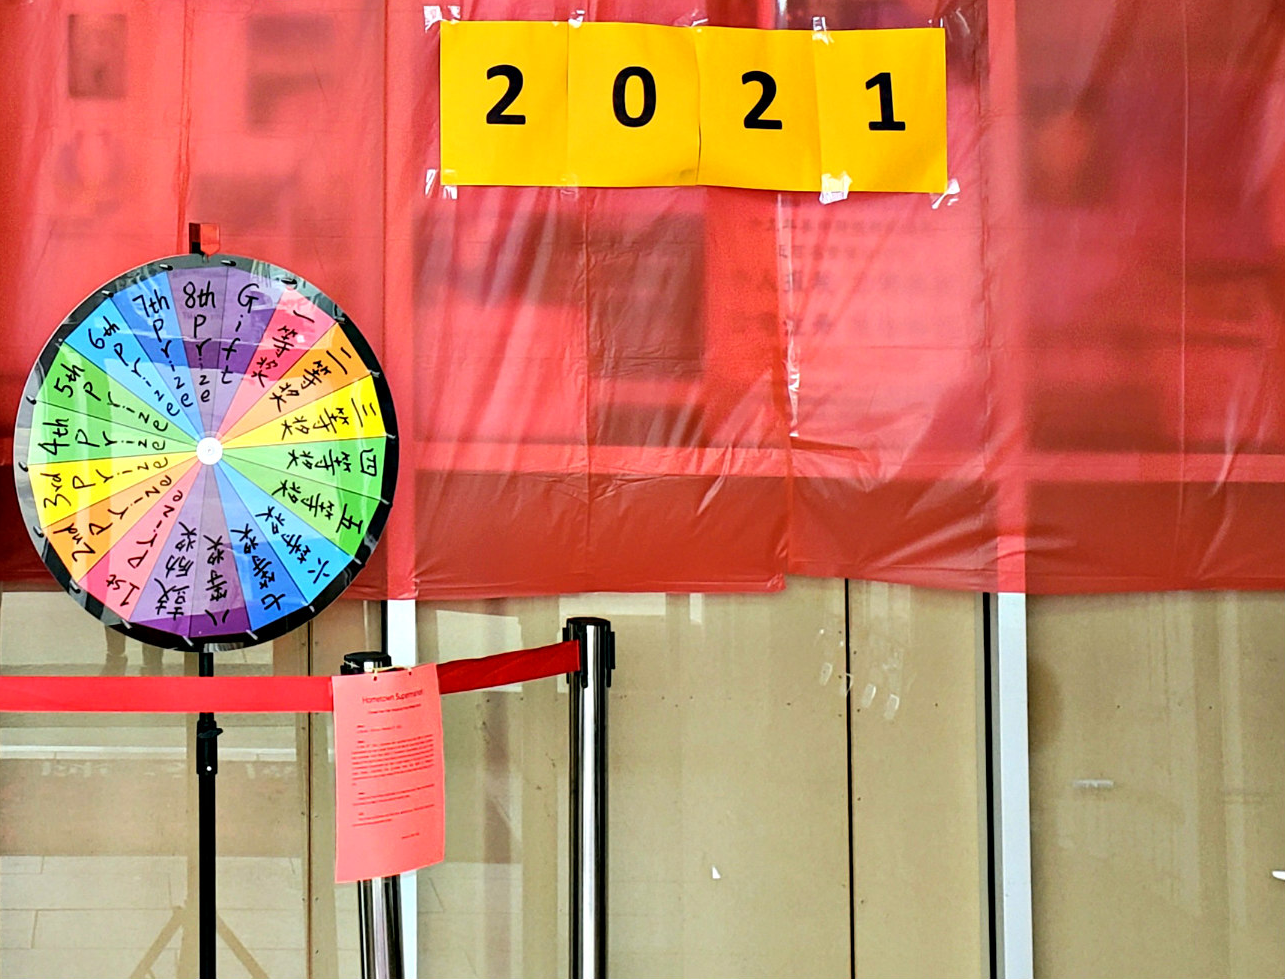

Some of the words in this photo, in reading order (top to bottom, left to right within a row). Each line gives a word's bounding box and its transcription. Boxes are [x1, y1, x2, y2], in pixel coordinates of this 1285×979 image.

[485, 64, 906, 131] 2021
[182, 280, 216, 309] 8th
[221, 282, 260, 385] Gift
[88, 315, 121, 350] 6th
[113, 342, 181, 417] Prize
[132, 289, 171, 318] 7th
[152, 318, 194, 408] Prize
[193, 314, 213, 402] Prize
[37, 417, 70, 456] 4th
[75, 428, 166, 451] Prize
[53, 362, 86, 398] 5th
[83, 381, 169, 432] Prize
[40, 472, 72, 509] 3rd
[72, 456, 169, 490] Prize
[52, 522, 97, 562] 2nd
[88, 474, 172, 536] Prize
[106, 574, 140, 607] 1st
[127, 489, 184, 569] Prize
